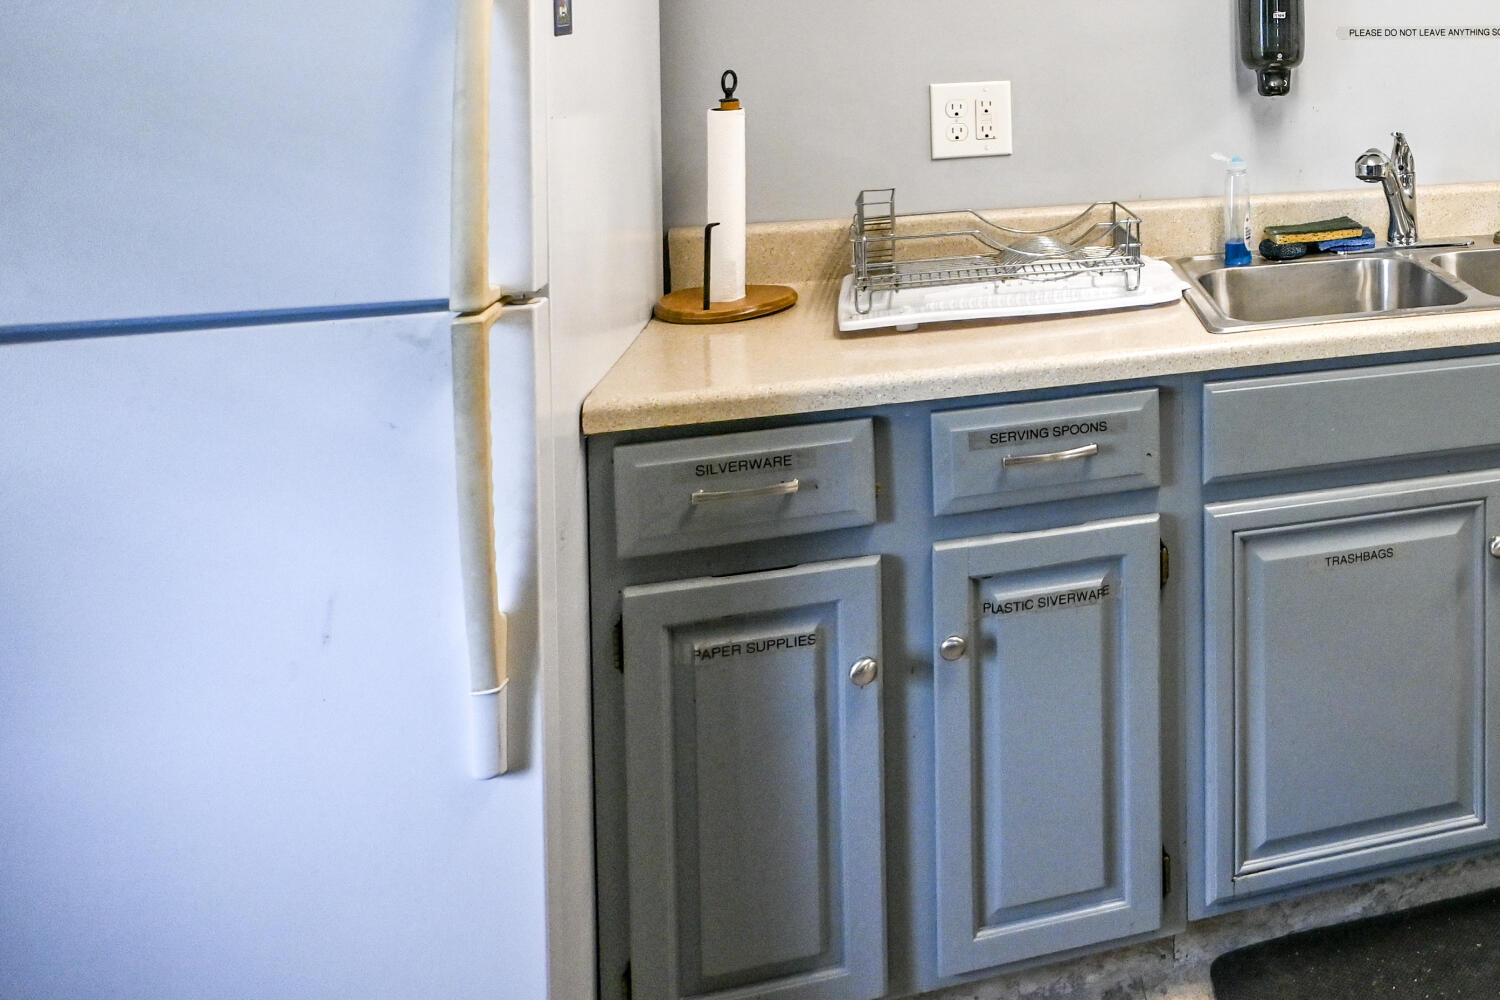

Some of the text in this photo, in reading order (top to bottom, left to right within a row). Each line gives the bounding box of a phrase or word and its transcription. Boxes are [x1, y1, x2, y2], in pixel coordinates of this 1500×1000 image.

[1349, 28, 1382, 38] PLEASE
[1384, 28, 1398, 37] DO
[1399, 28, 1417, 37] NOT
[1419, 28, 1446, 37] LEAVE
[1447, 28, 1490, 37] ANYTHING
[989, 421, 1108, 445] SERVING SPOONS
[695, 454, 793, 477] SILVERWARE
[1325, 547, 1394, 567] TRASHBAGS
[983, 584, 1110, 615] PLASTIC SIVERWARE
[693, 633, 817, 661] PAPER SUPPLIES
